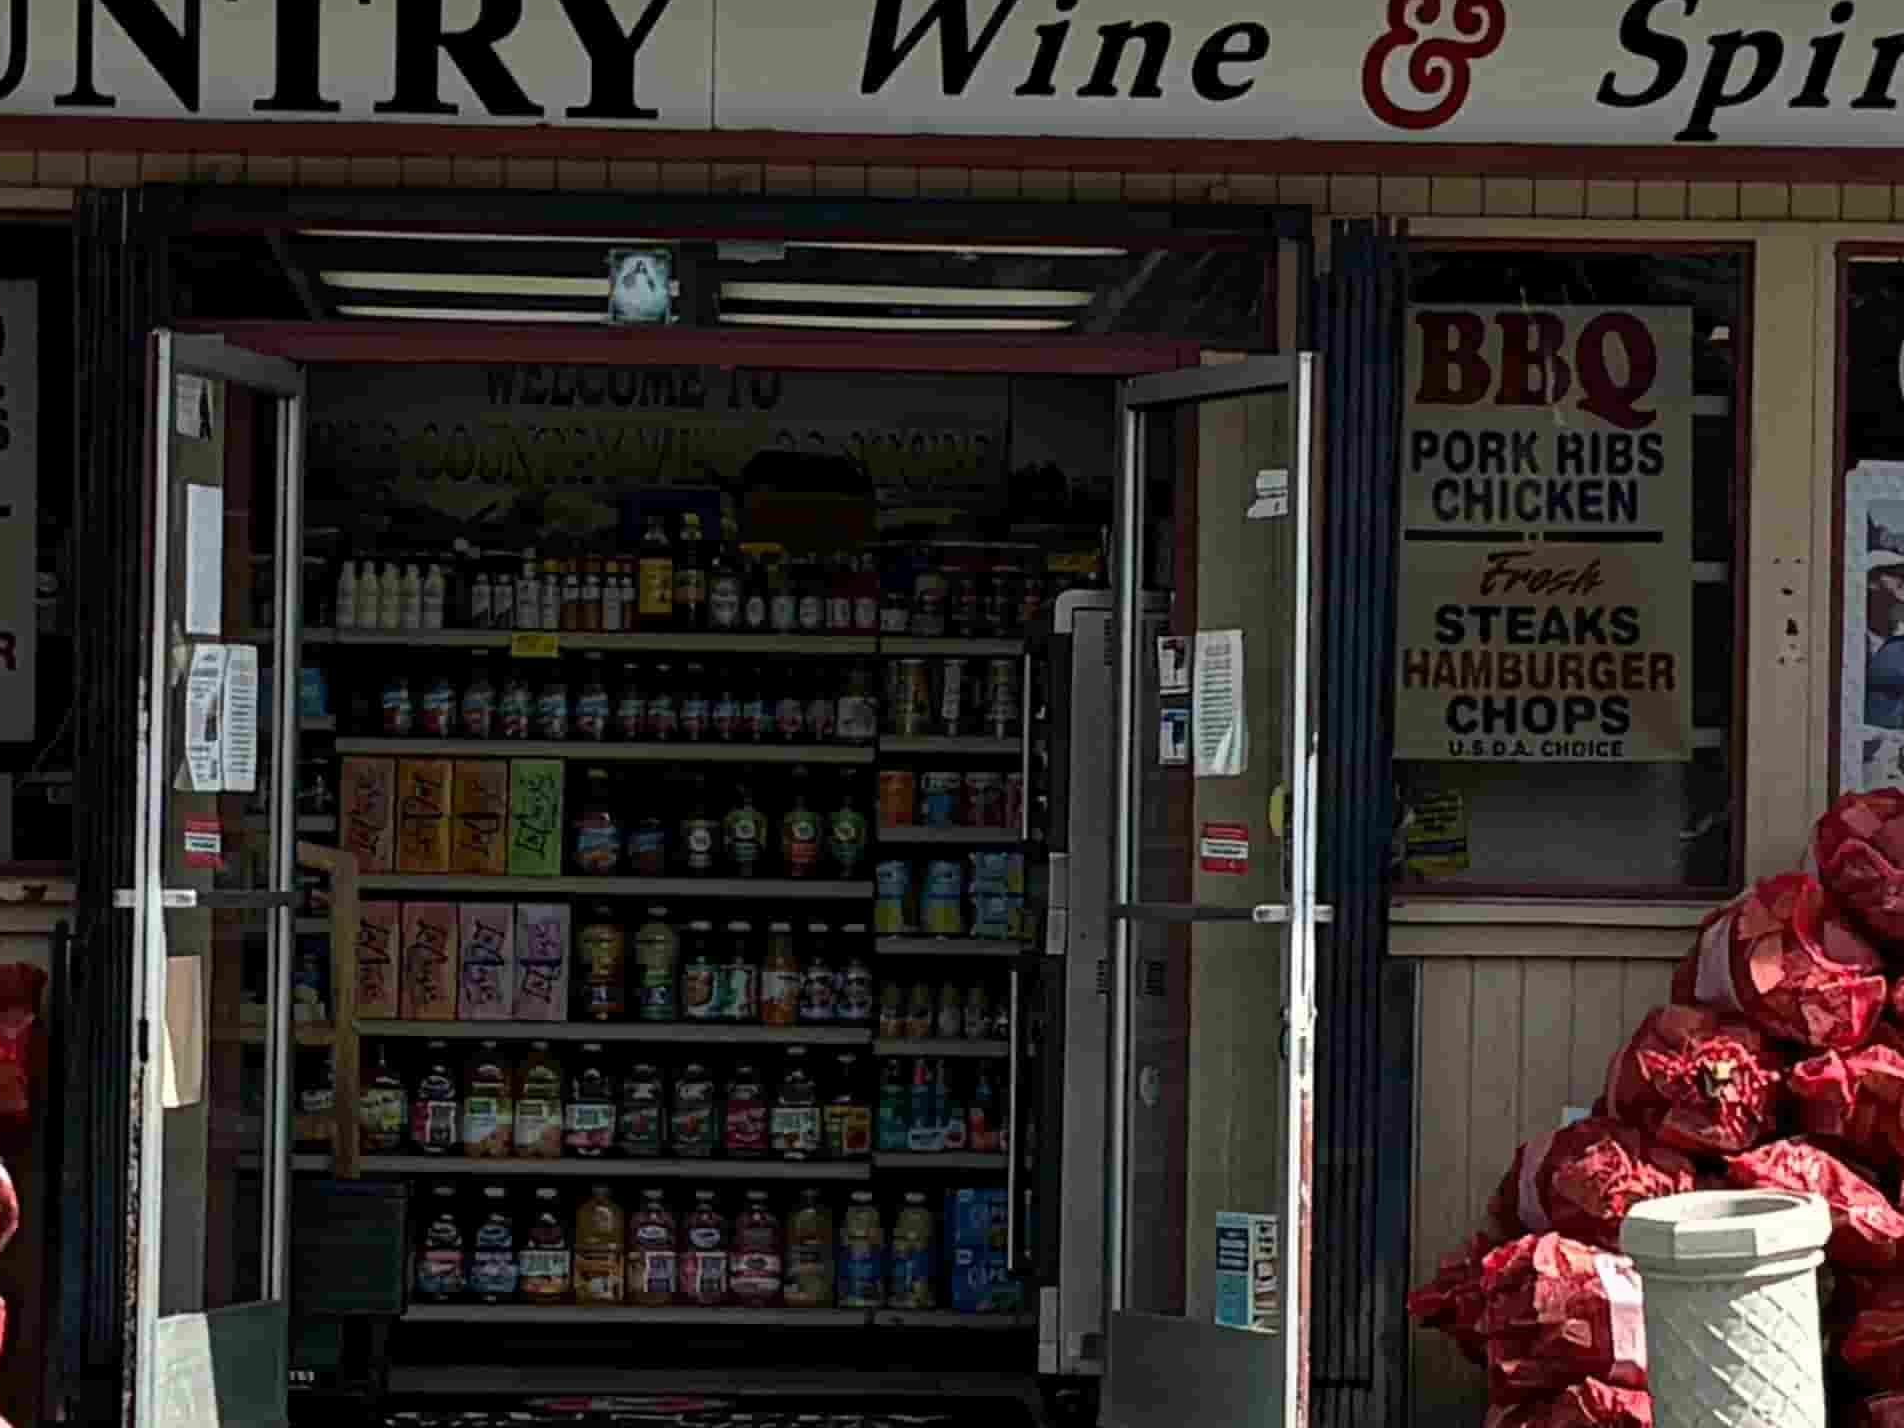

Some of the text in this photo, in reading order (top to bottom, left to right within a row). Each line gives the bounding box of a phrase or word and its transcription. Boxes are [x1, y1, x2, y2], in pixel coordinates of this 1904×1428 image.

[487, 365, 706, 409] WELCOME
[1414, 311, 1658, 429] BBQ
[1412, 430, 1664, 476] PORK RIBS
[1433, 479, 1639, 522] CHICKEN
[1480, 550, 1604, 596] Fresh
[1434, 605, 1641, 646] STEAKS
[1403, 650, 1676, 691] HAMBURGER
[1446, 696, 1631, 736] CHOPS
[1541, 739, 1624, 758] CHOICE
